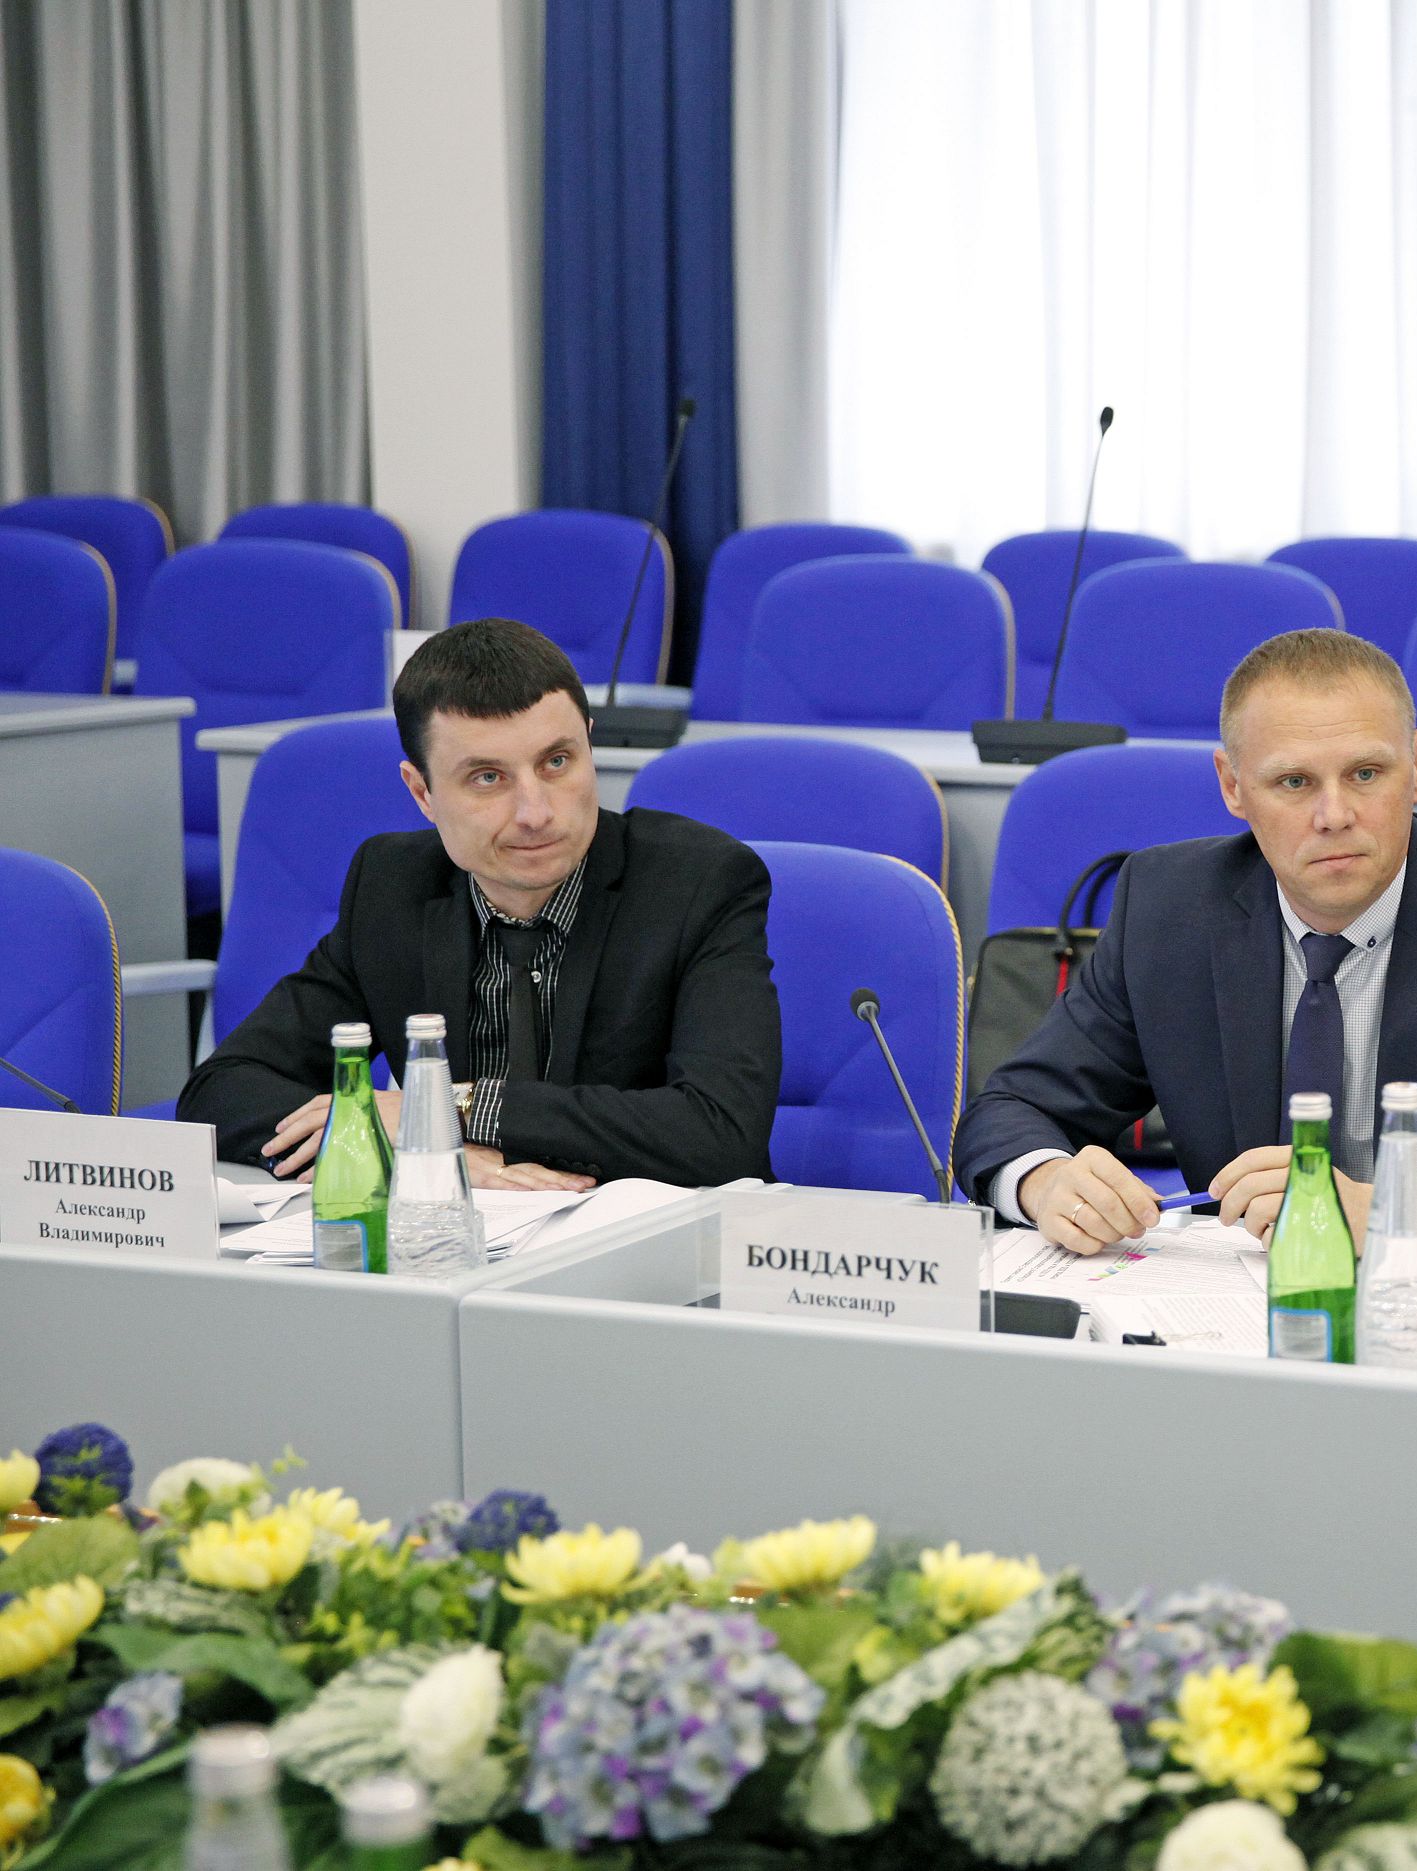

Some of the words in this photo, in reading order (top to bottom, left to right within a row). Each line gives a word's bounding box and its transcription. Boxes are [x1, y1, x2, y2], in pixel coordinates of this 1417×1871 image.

[24, 1160, 175, 1192] ЛИТВИНОВ
[56, 1199, 146, 1224] Александр
[39, 1222, 165, 1248] Владимирович
[747, 1244, 939, 1284] БОНДАРЧУК
[787, 1288, 896, 1317] Александр
